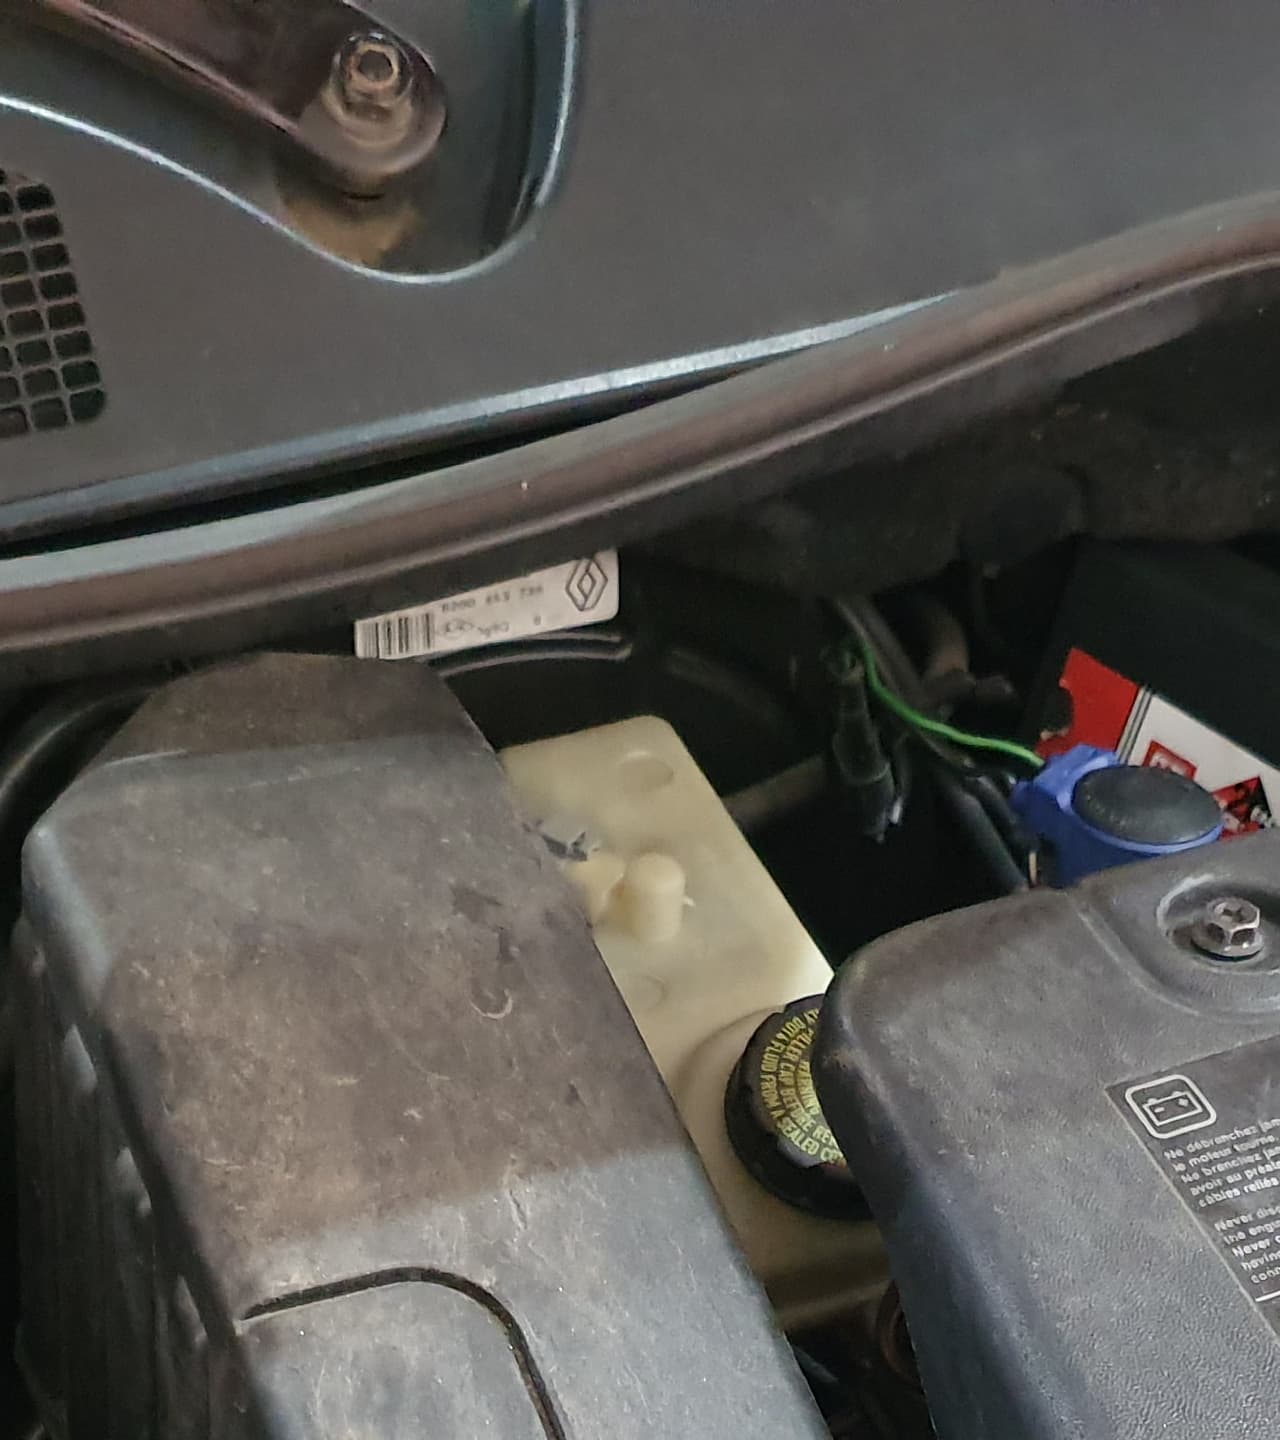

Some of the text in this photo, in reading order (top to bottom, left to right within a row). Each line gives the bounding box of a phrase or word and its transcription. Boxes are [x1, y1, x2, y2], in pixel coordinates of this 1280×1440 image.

[776, 1116, 820, 1156] SEALED
[1187, 1147, 1232, 1167] moteur
[1213, 1212, 1253, 1232] Never
[1231, 1237, 1270, 1257] Never
